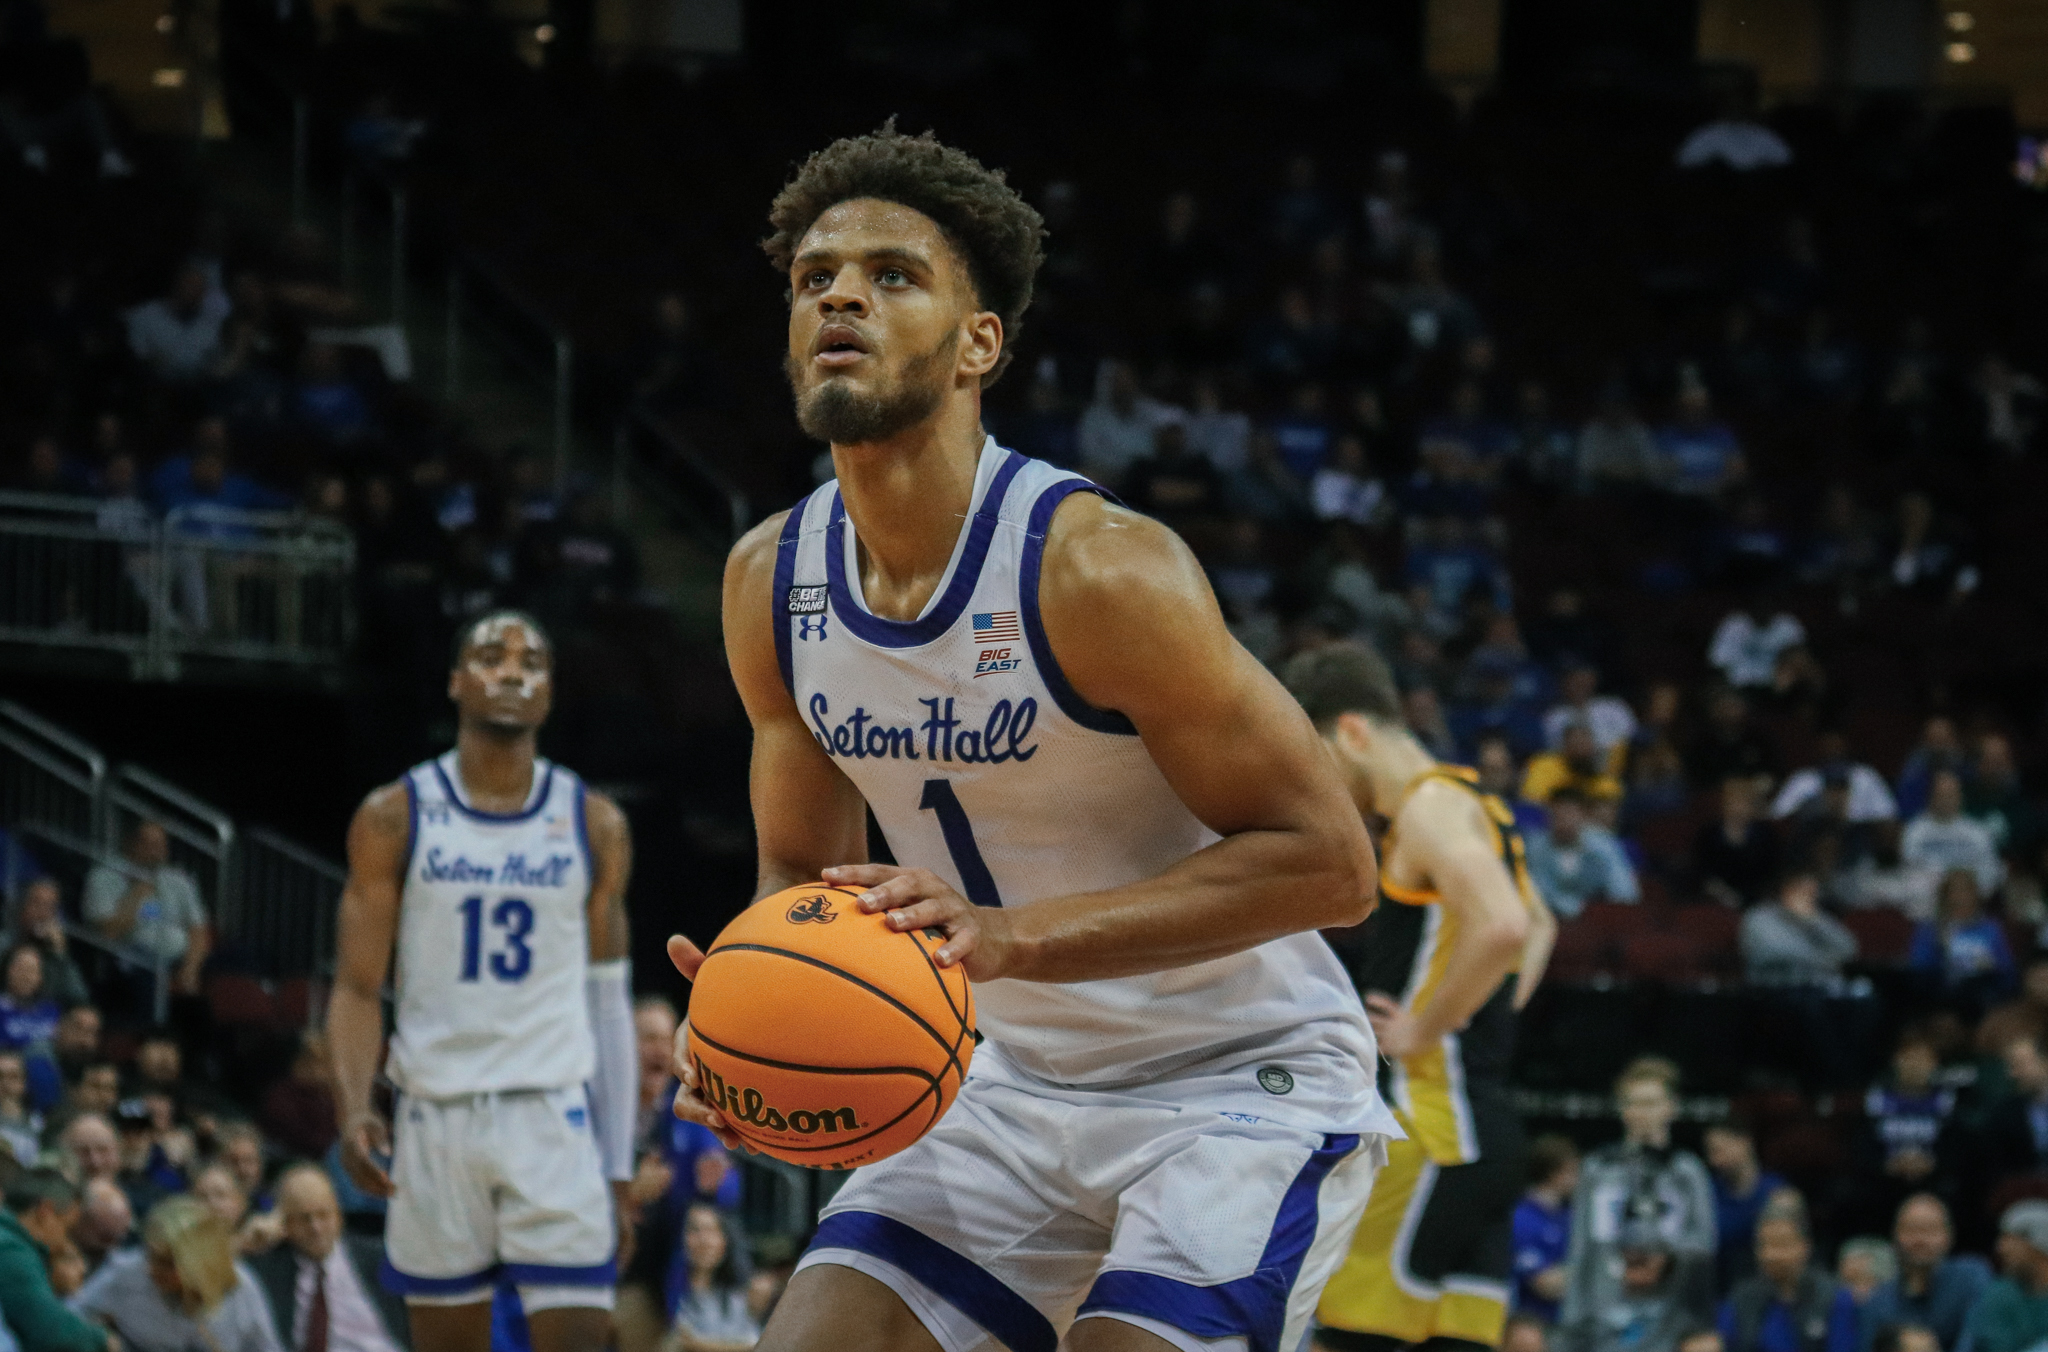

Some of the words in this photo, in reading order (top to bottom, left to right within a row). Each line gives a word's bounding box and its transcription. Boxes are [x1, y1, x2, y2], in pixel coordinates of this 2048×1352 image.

[975, 659, 1022, 672] EAST
[979, 648, 1011, 661] BIG
[809, 692, 920, 760] Seton
[918, 697, 1039, 765] Hall
[918, 779, 1003, 908] 1
[457, 896, 535, 984] 13
[694, 1052, 861, 1135] Wilson
